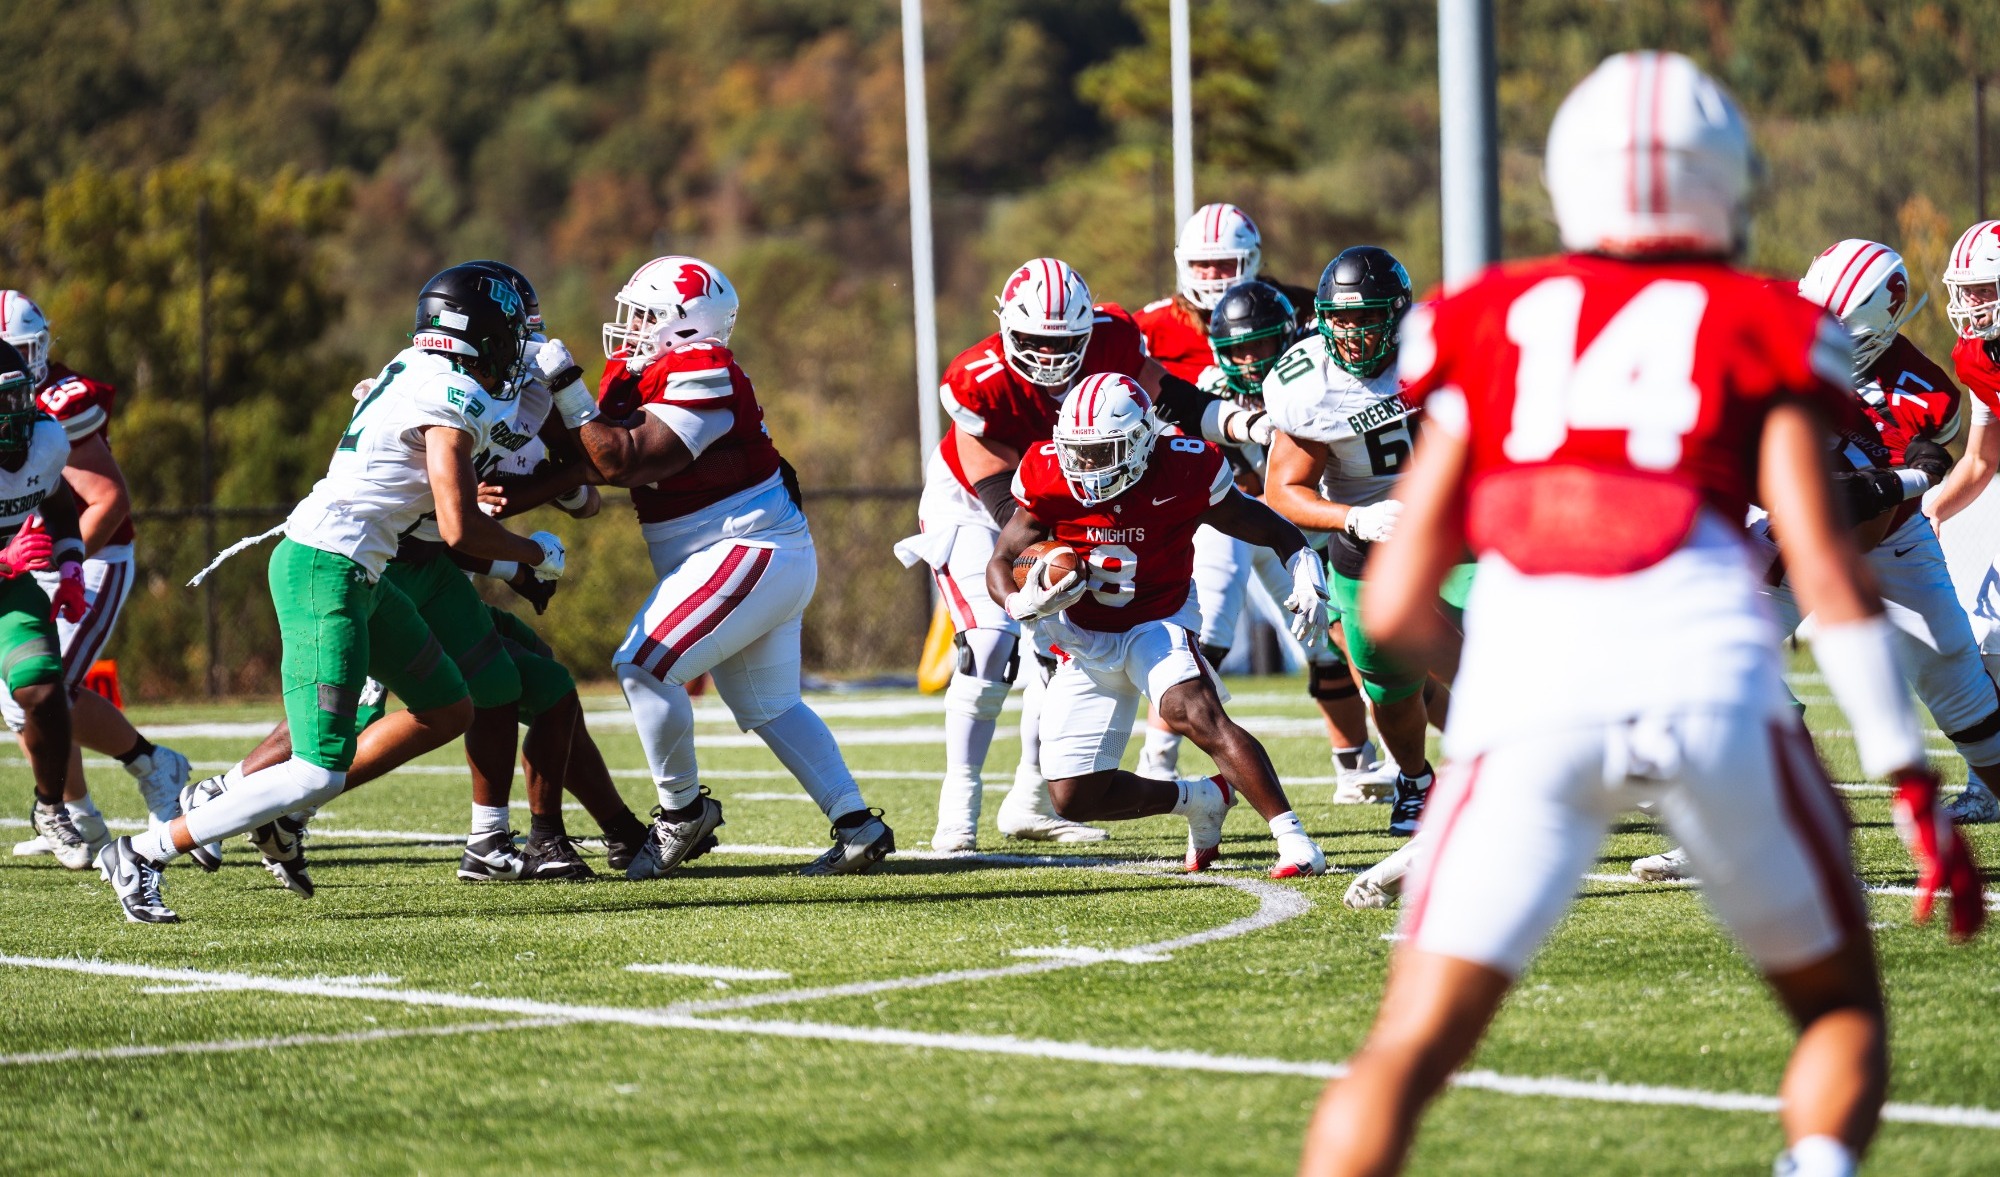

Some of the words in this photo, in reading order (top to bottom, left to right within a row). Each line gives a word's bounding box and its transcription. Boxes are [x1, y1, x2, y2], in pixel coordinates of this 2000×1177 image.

[1042, 323, 1067, 331] KNIGHTS
[415, 336, 453, 350] Riddell
[964, 348, 1005, 384] 71
[1504, 275, 1709, 473] 14
[1891, 370, 1934, 410] 77
[1170, 438, 1205, 454] 8
[1085, 526, 1145, 543] KNIGHTS
[1087, 544, 1138, 608] 8
